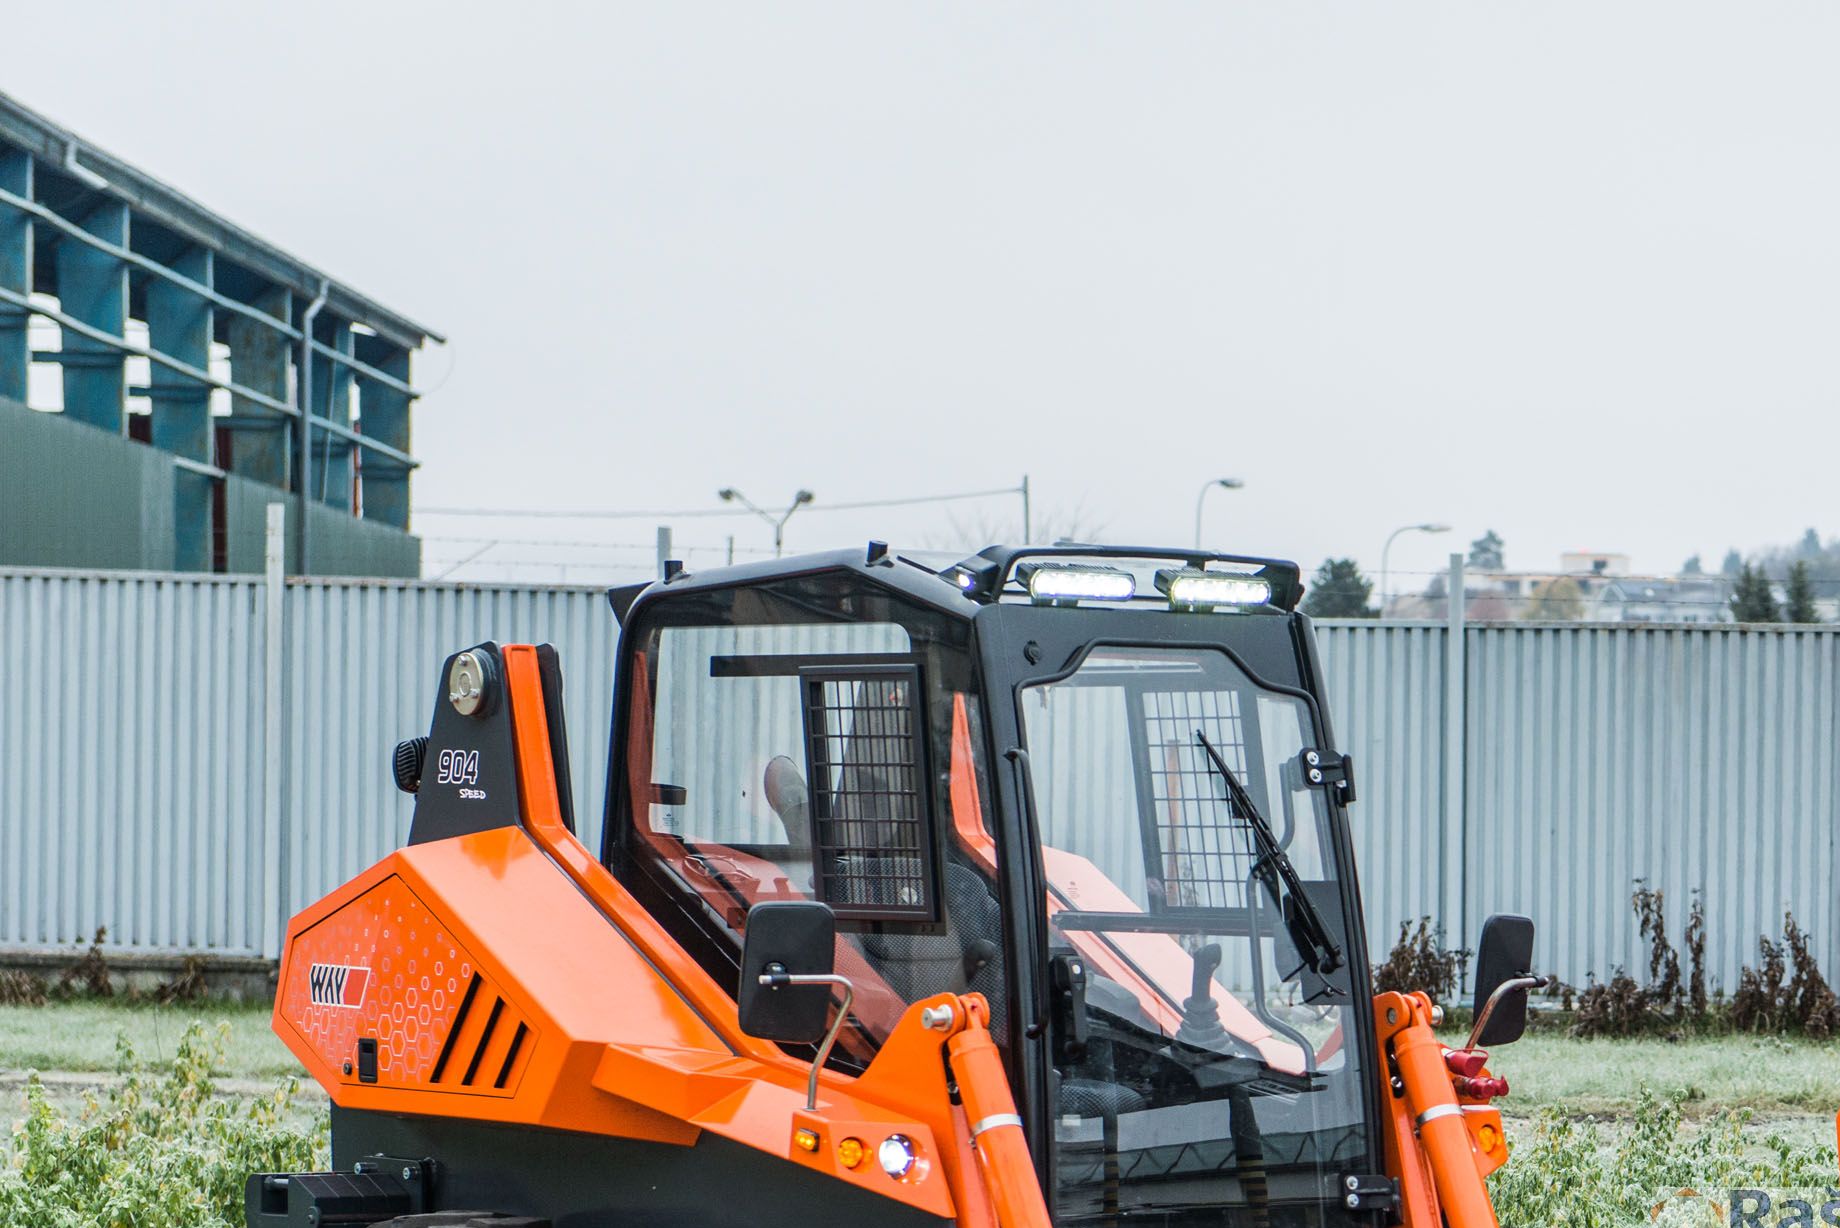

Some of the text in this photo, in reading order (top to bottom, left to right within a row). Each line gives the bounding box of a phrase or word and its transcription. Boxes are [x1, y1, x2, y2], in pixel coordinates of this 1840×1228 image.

[438, 749, 479, 785] 904
[459, 788, 487, 799] SPEED
[309, 963, 348, 1007] WAY
